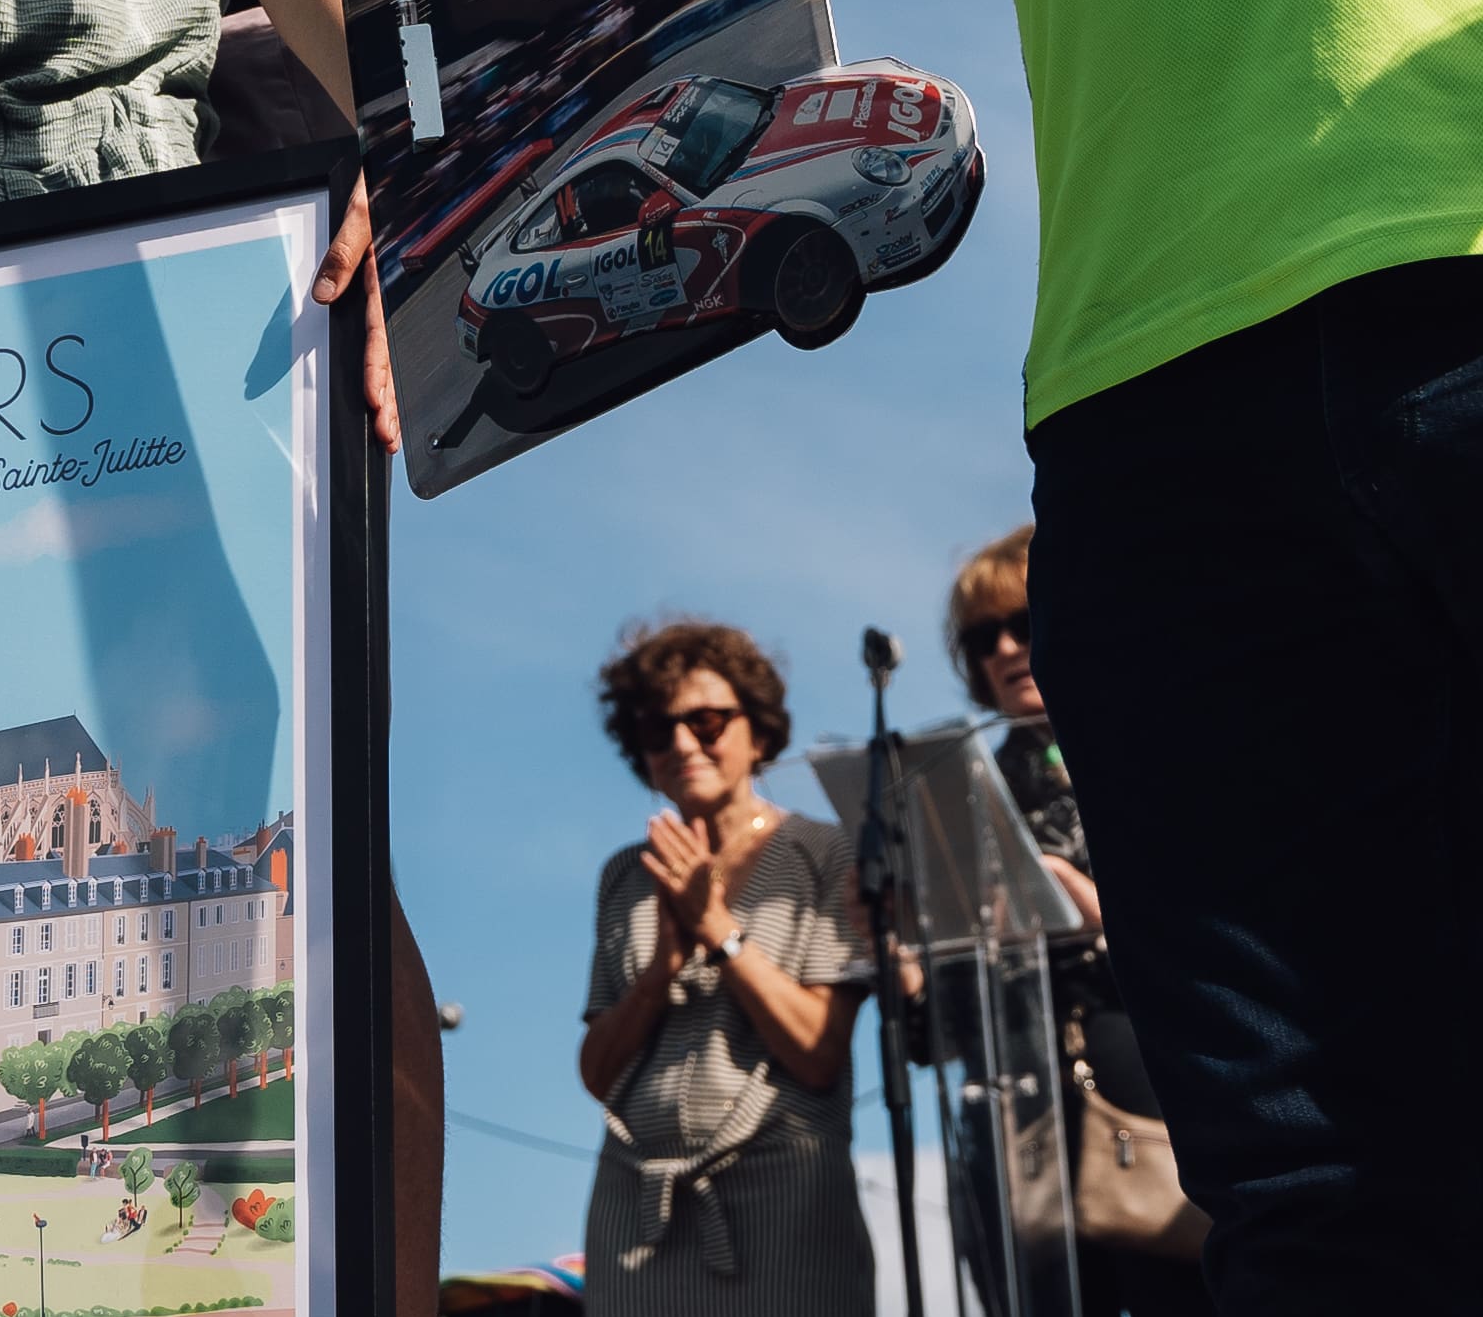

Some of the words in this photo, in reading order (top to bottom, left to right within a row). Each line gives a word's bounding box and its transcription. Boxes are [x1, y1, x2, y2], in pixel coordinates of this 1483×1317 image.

[594, 244, 637, 276] IGOL
[645, 230, 667, 264] 14
[695, 294, 724, 312] NGK
